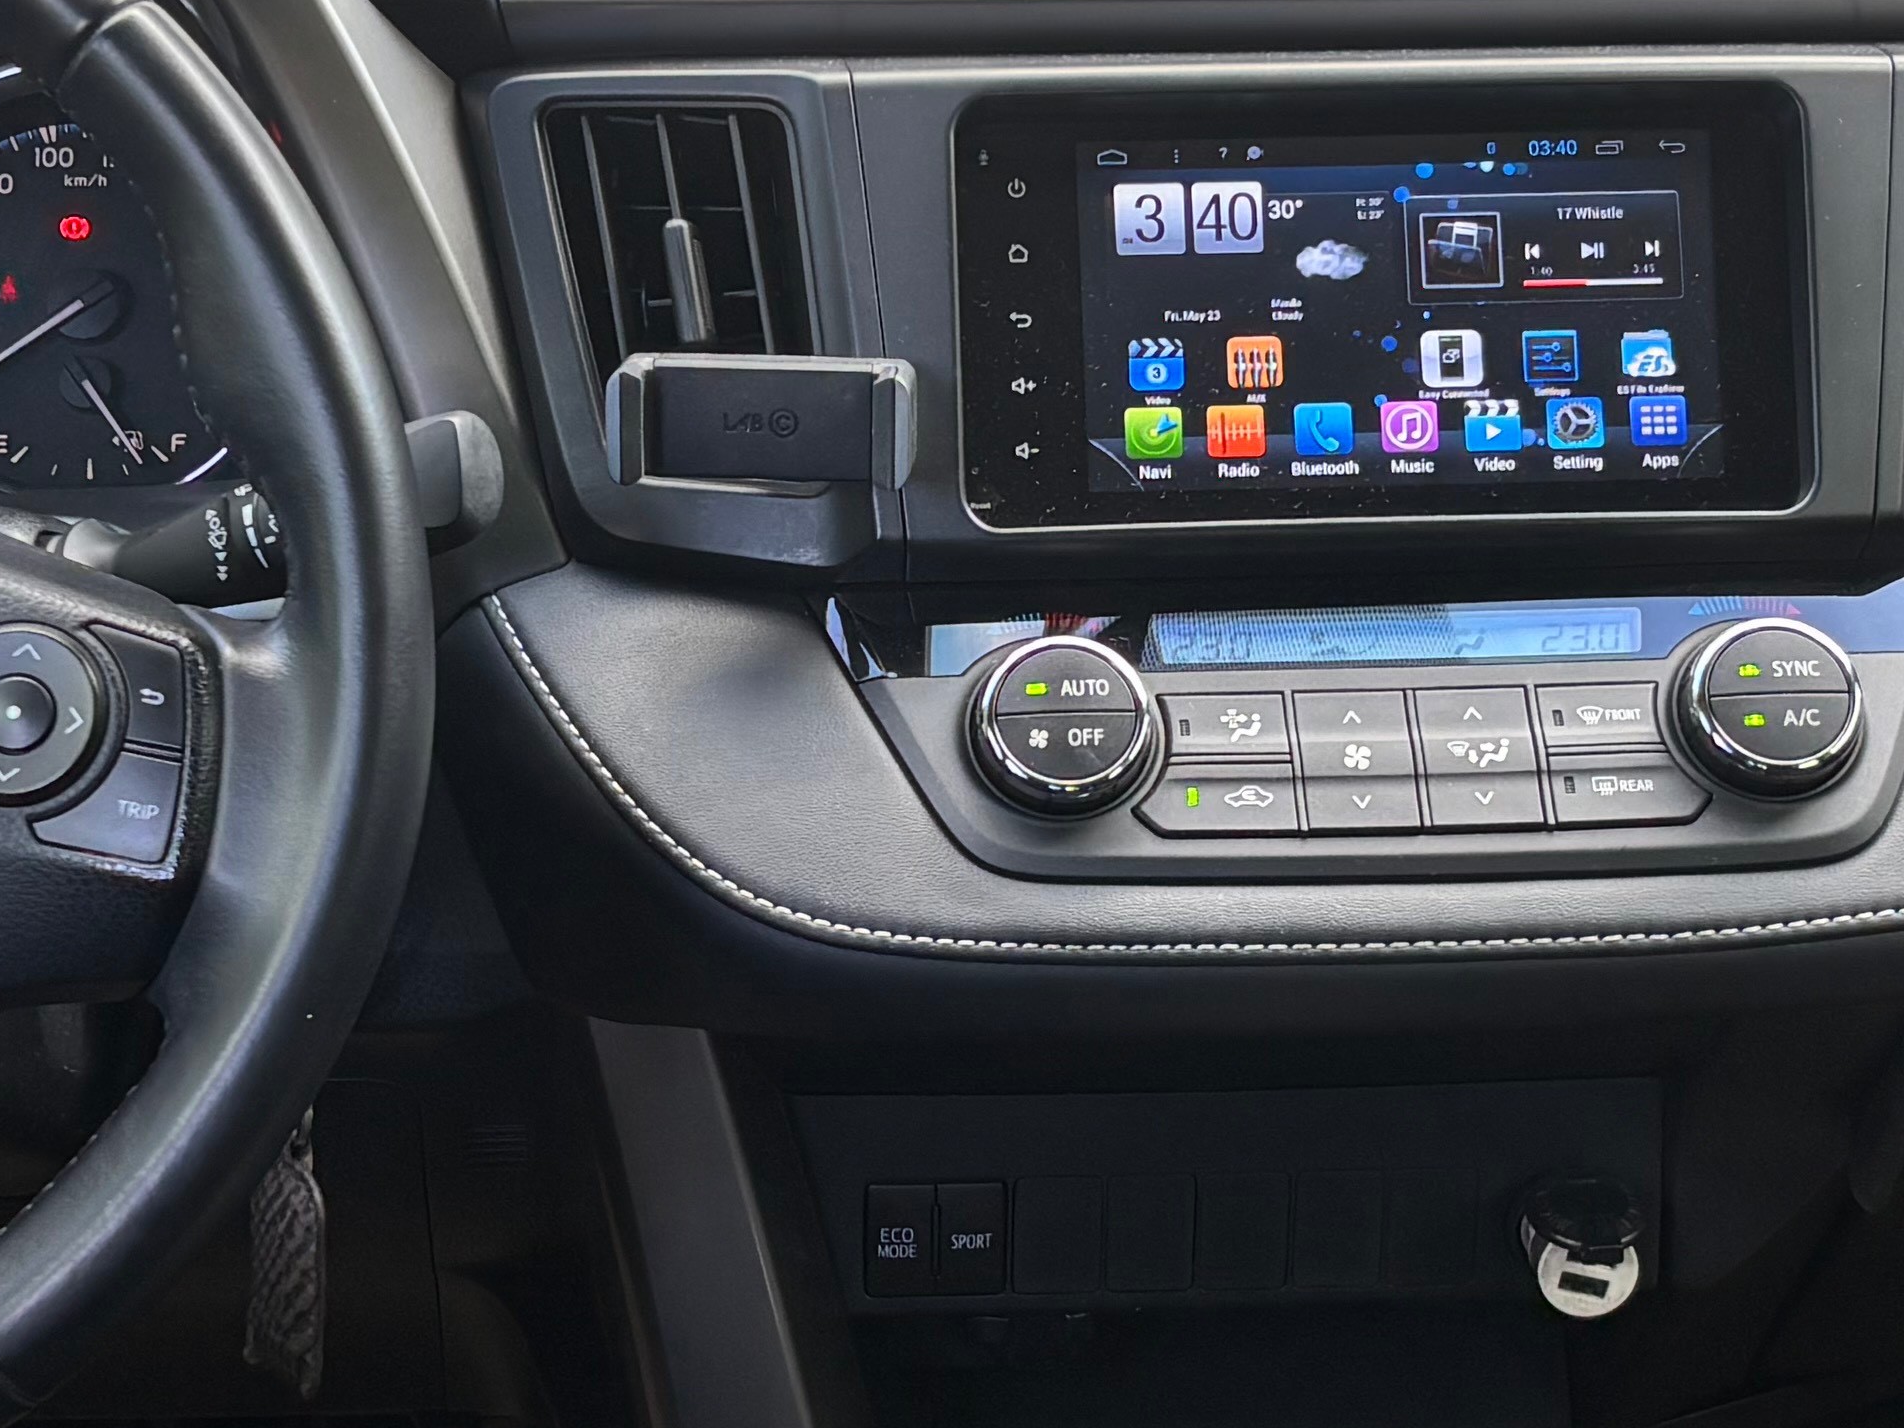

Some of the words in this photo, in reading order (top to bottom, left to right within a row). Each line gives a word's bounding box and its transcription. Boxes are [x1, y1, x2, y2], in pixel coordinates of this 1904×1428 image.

[1528, 139, 1578, 156] 03:40
[34, 147, 74, 169] 100
[63, 174, 108, 188] km/h
[1196, 192, 1259, 242] 40
[1267, 198, 1304, 220] 30°
[1556, 207, 1573, 220] 17
[1575, 206, 1624, 220] Whistle
[1134, 193, 1165, 243] 3
[1144, 395, 1172, 406] Video
[170, 433, 187, 452] F
[1291, 460, 1360, 477] Bluetooth
[1391, 458, 1435, 474] Music
[1474, 456, 1516, 472] Video
[1553, 454, 1603, 472] Setting
[1642, 453, 1680, 470] Apps
[1139, 464, 1172, 480] Navi
[1218, 463, 1260, 478] Radio
[1772, 660, 1822, 678] SYNC
[1060, 679, 1110, 697] AUTO
[1604, 707, 1642, 722] FRONT
[1783, 708, 1822, 726] A/C
[1068, 728, 1105, 746] OFF
[1620, 778, 1655, 793] REAR
[117, 799, 160, 820] TRIP
[880, 1228, 914, 1243] ECO
[951, 1233, 993, 1250] SPORT
[878, 1244, 917, 1259] MODE
